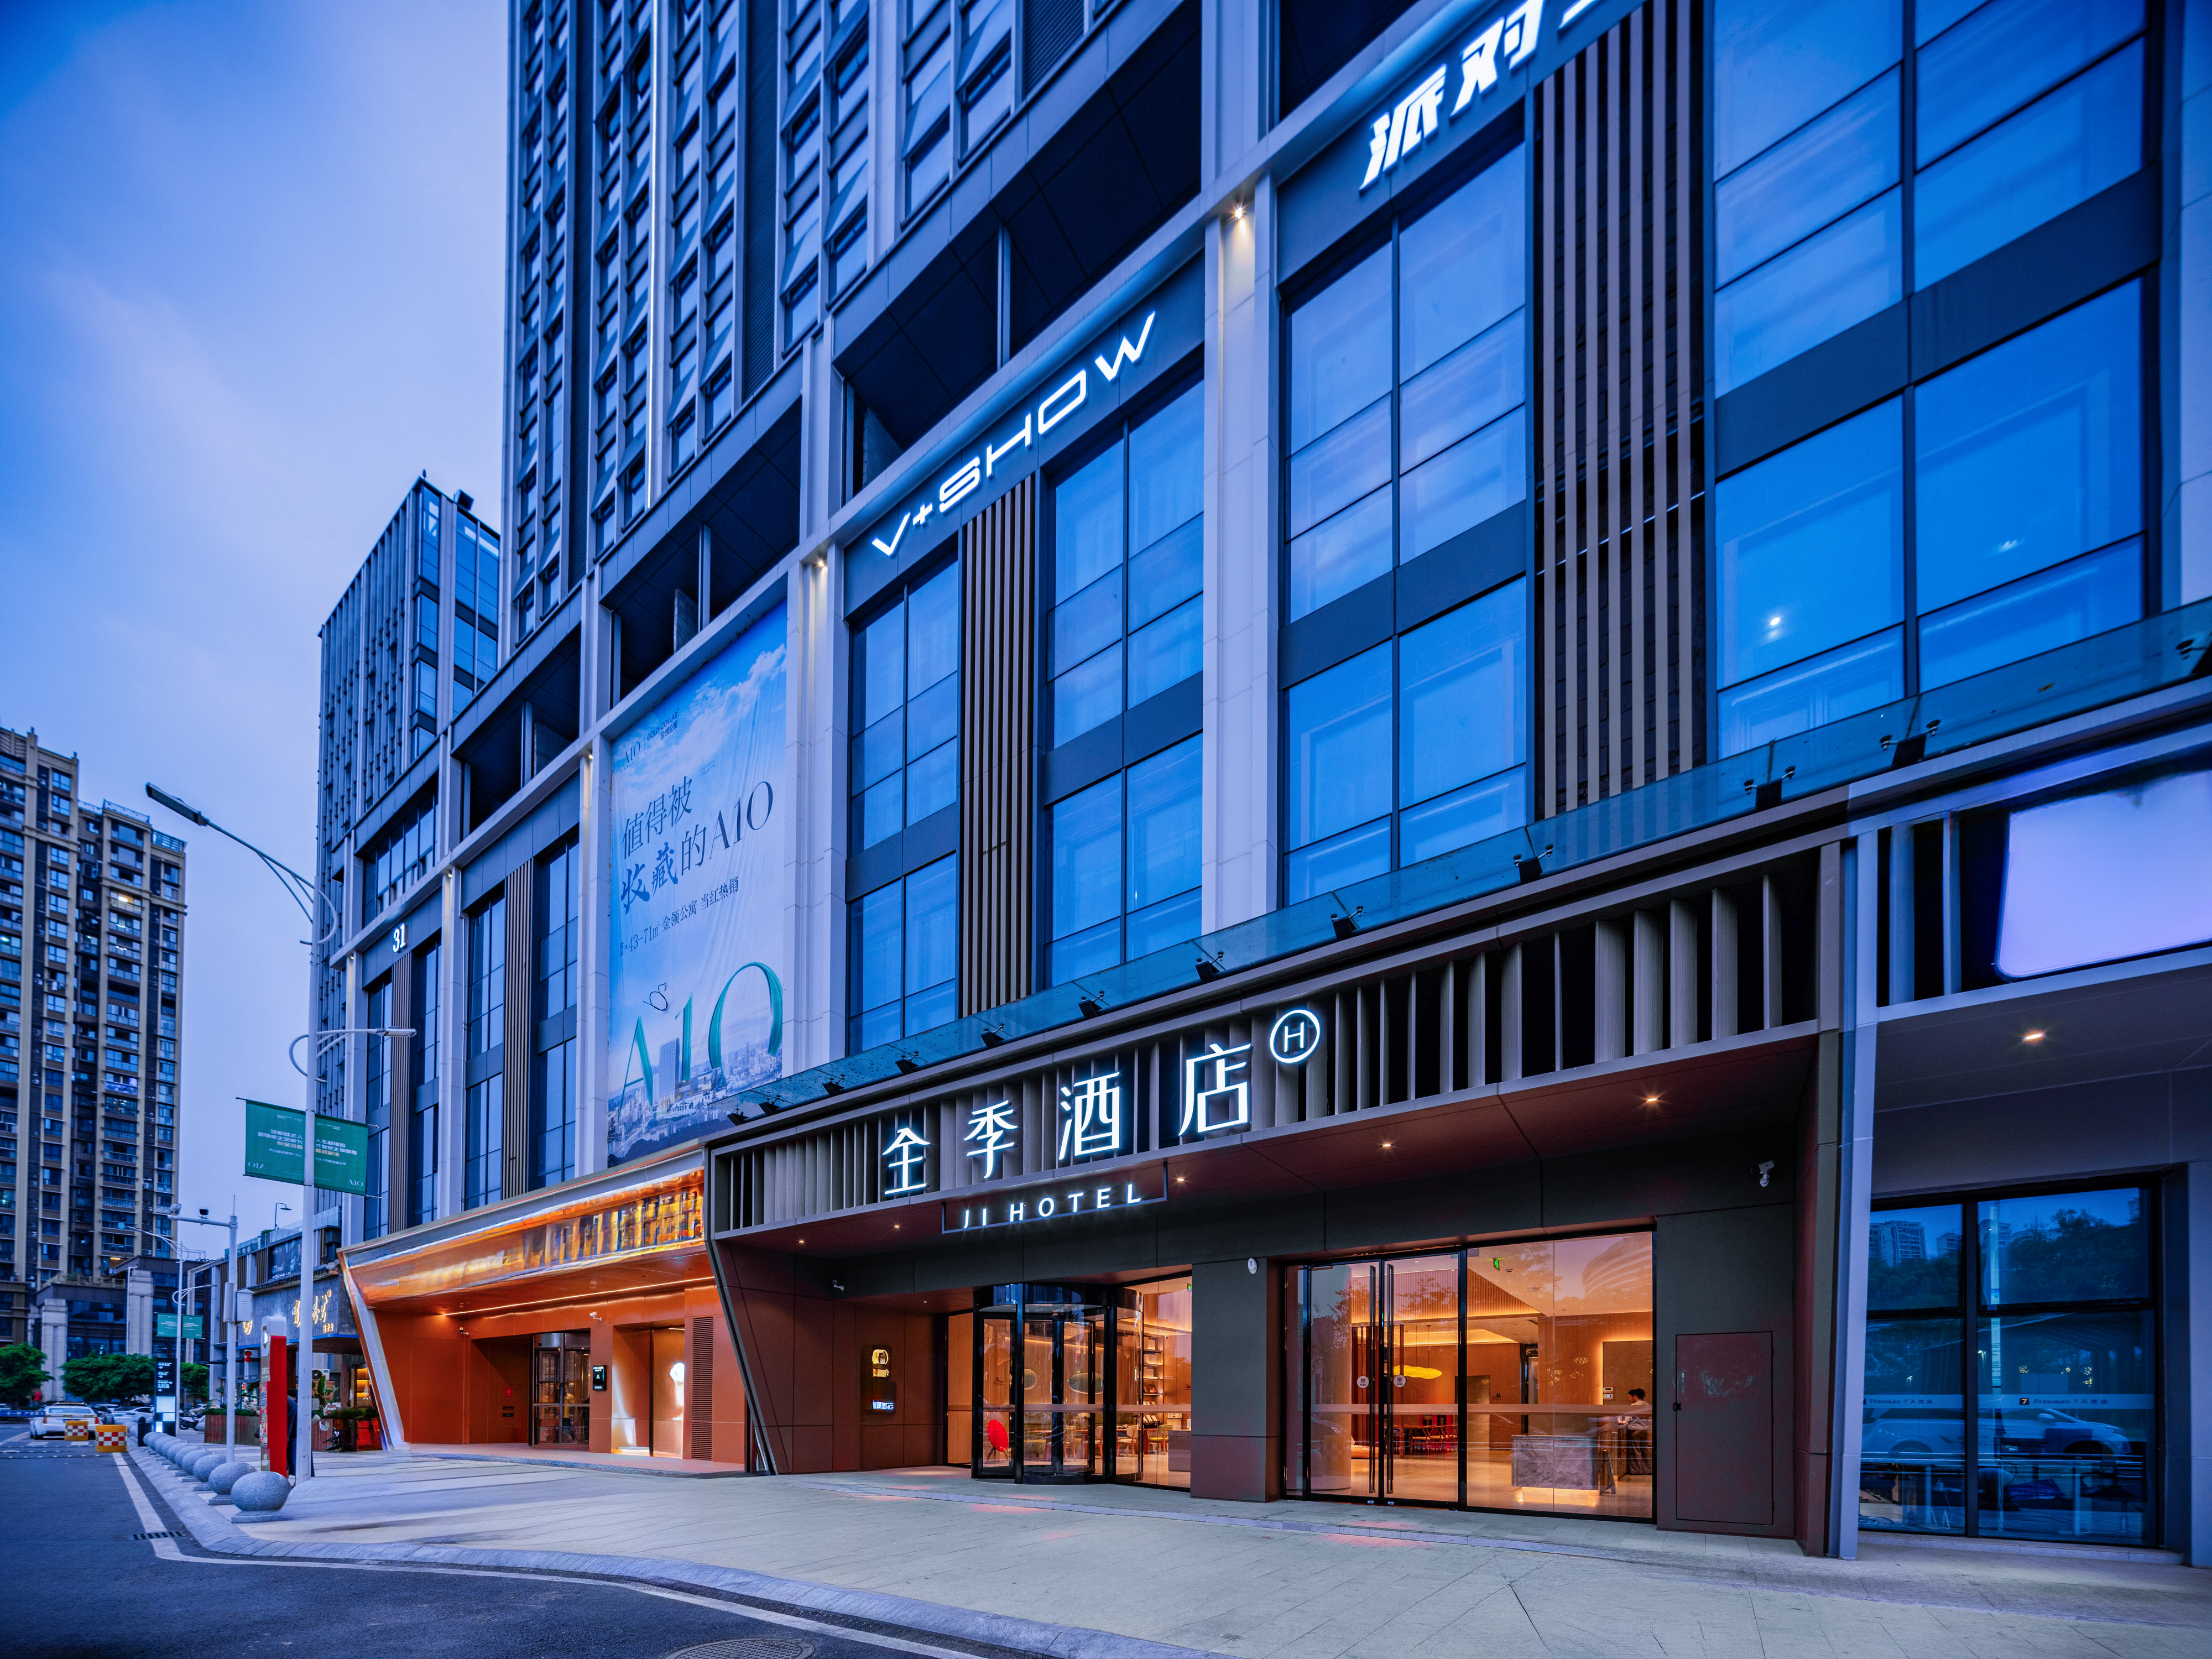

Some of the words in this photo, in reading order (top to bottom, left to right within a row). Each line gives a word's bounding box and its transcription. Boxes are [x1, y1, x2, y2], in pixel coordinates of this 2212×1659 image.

[1361, 0, 1595, 190] 派对
[392, 923, 406, 952] 31
[881, 1043, 1252, 1196] 全季酒店
[963, 1208, 987, 1229] JI
[1009, 1183, 1141, 1223] HOTEL
